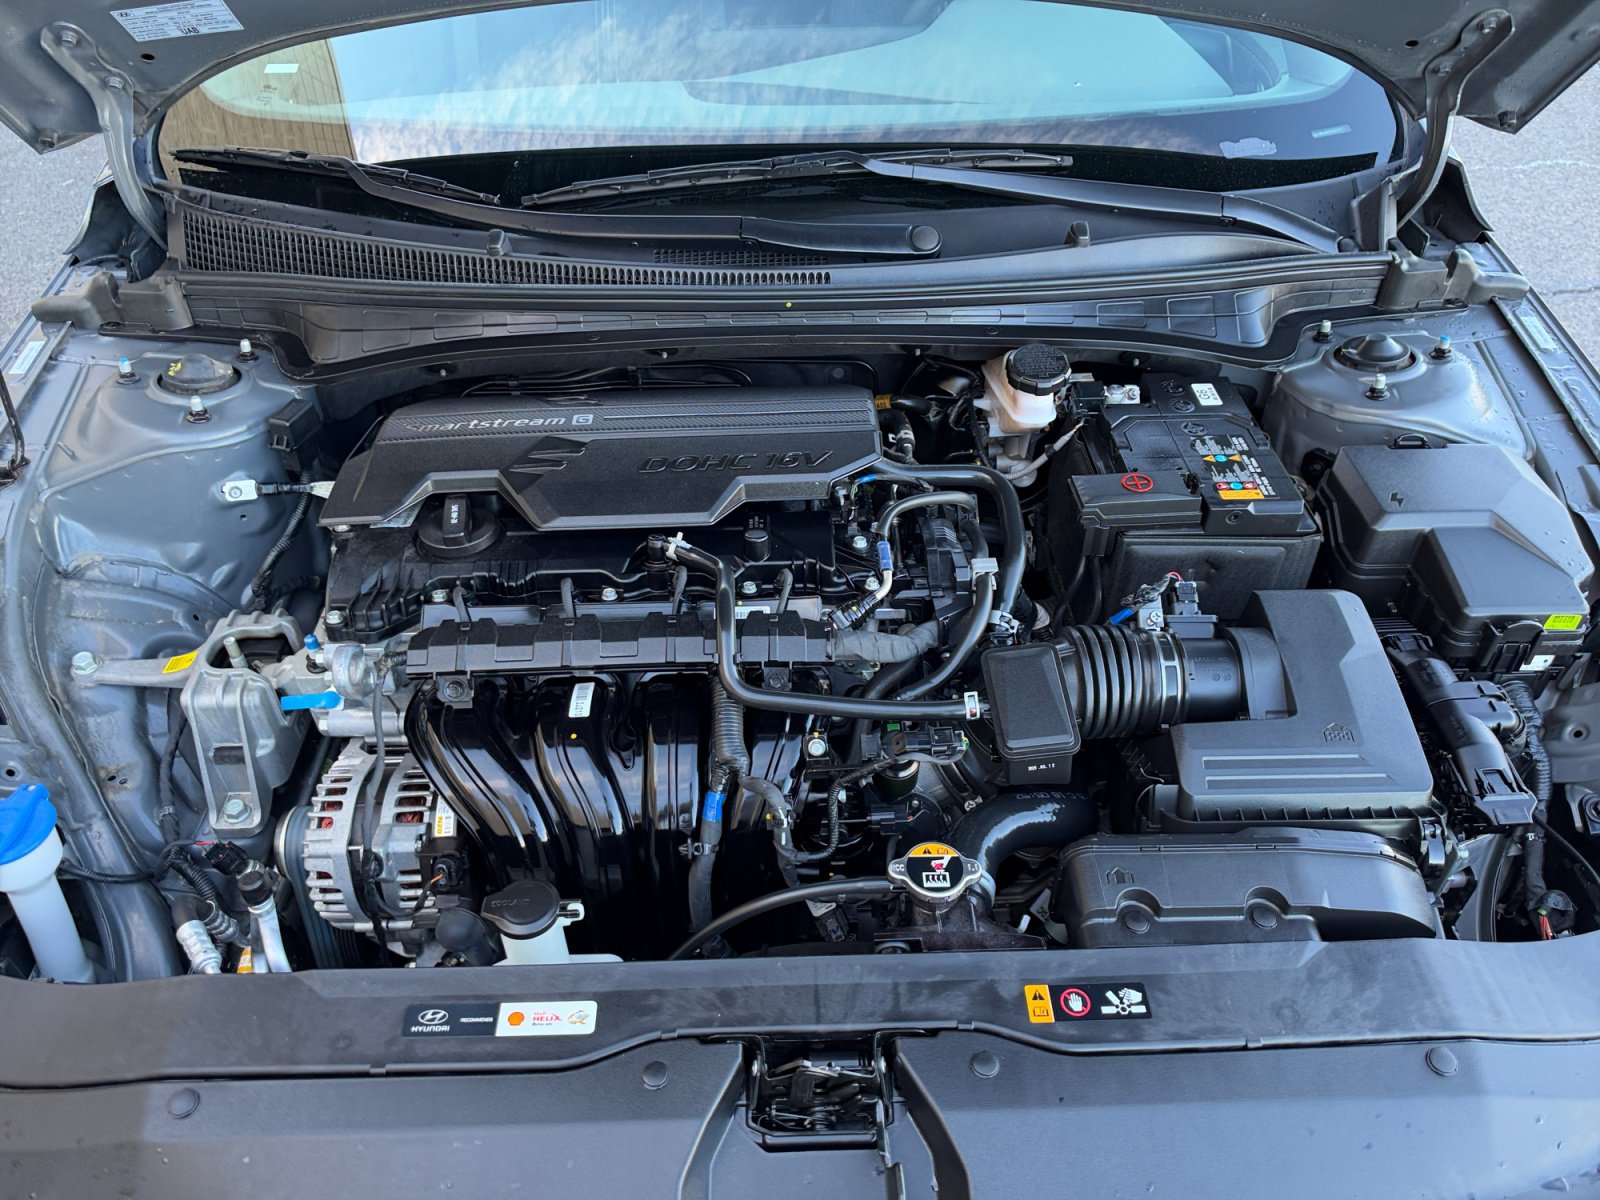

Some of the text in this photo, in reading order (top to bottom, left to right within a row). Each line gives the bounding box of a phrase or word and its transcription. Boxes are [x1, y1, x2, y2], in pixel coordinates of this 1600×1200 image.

[181, 26, 200, 35] UAB
[404, 415, 593, 432] Smartstream G
[639, 450, 834, 473] DOHC 16V
[532, 1014, 561, 1022] HELIX
[411, 1025, 450, 1033] HYUNDAI
